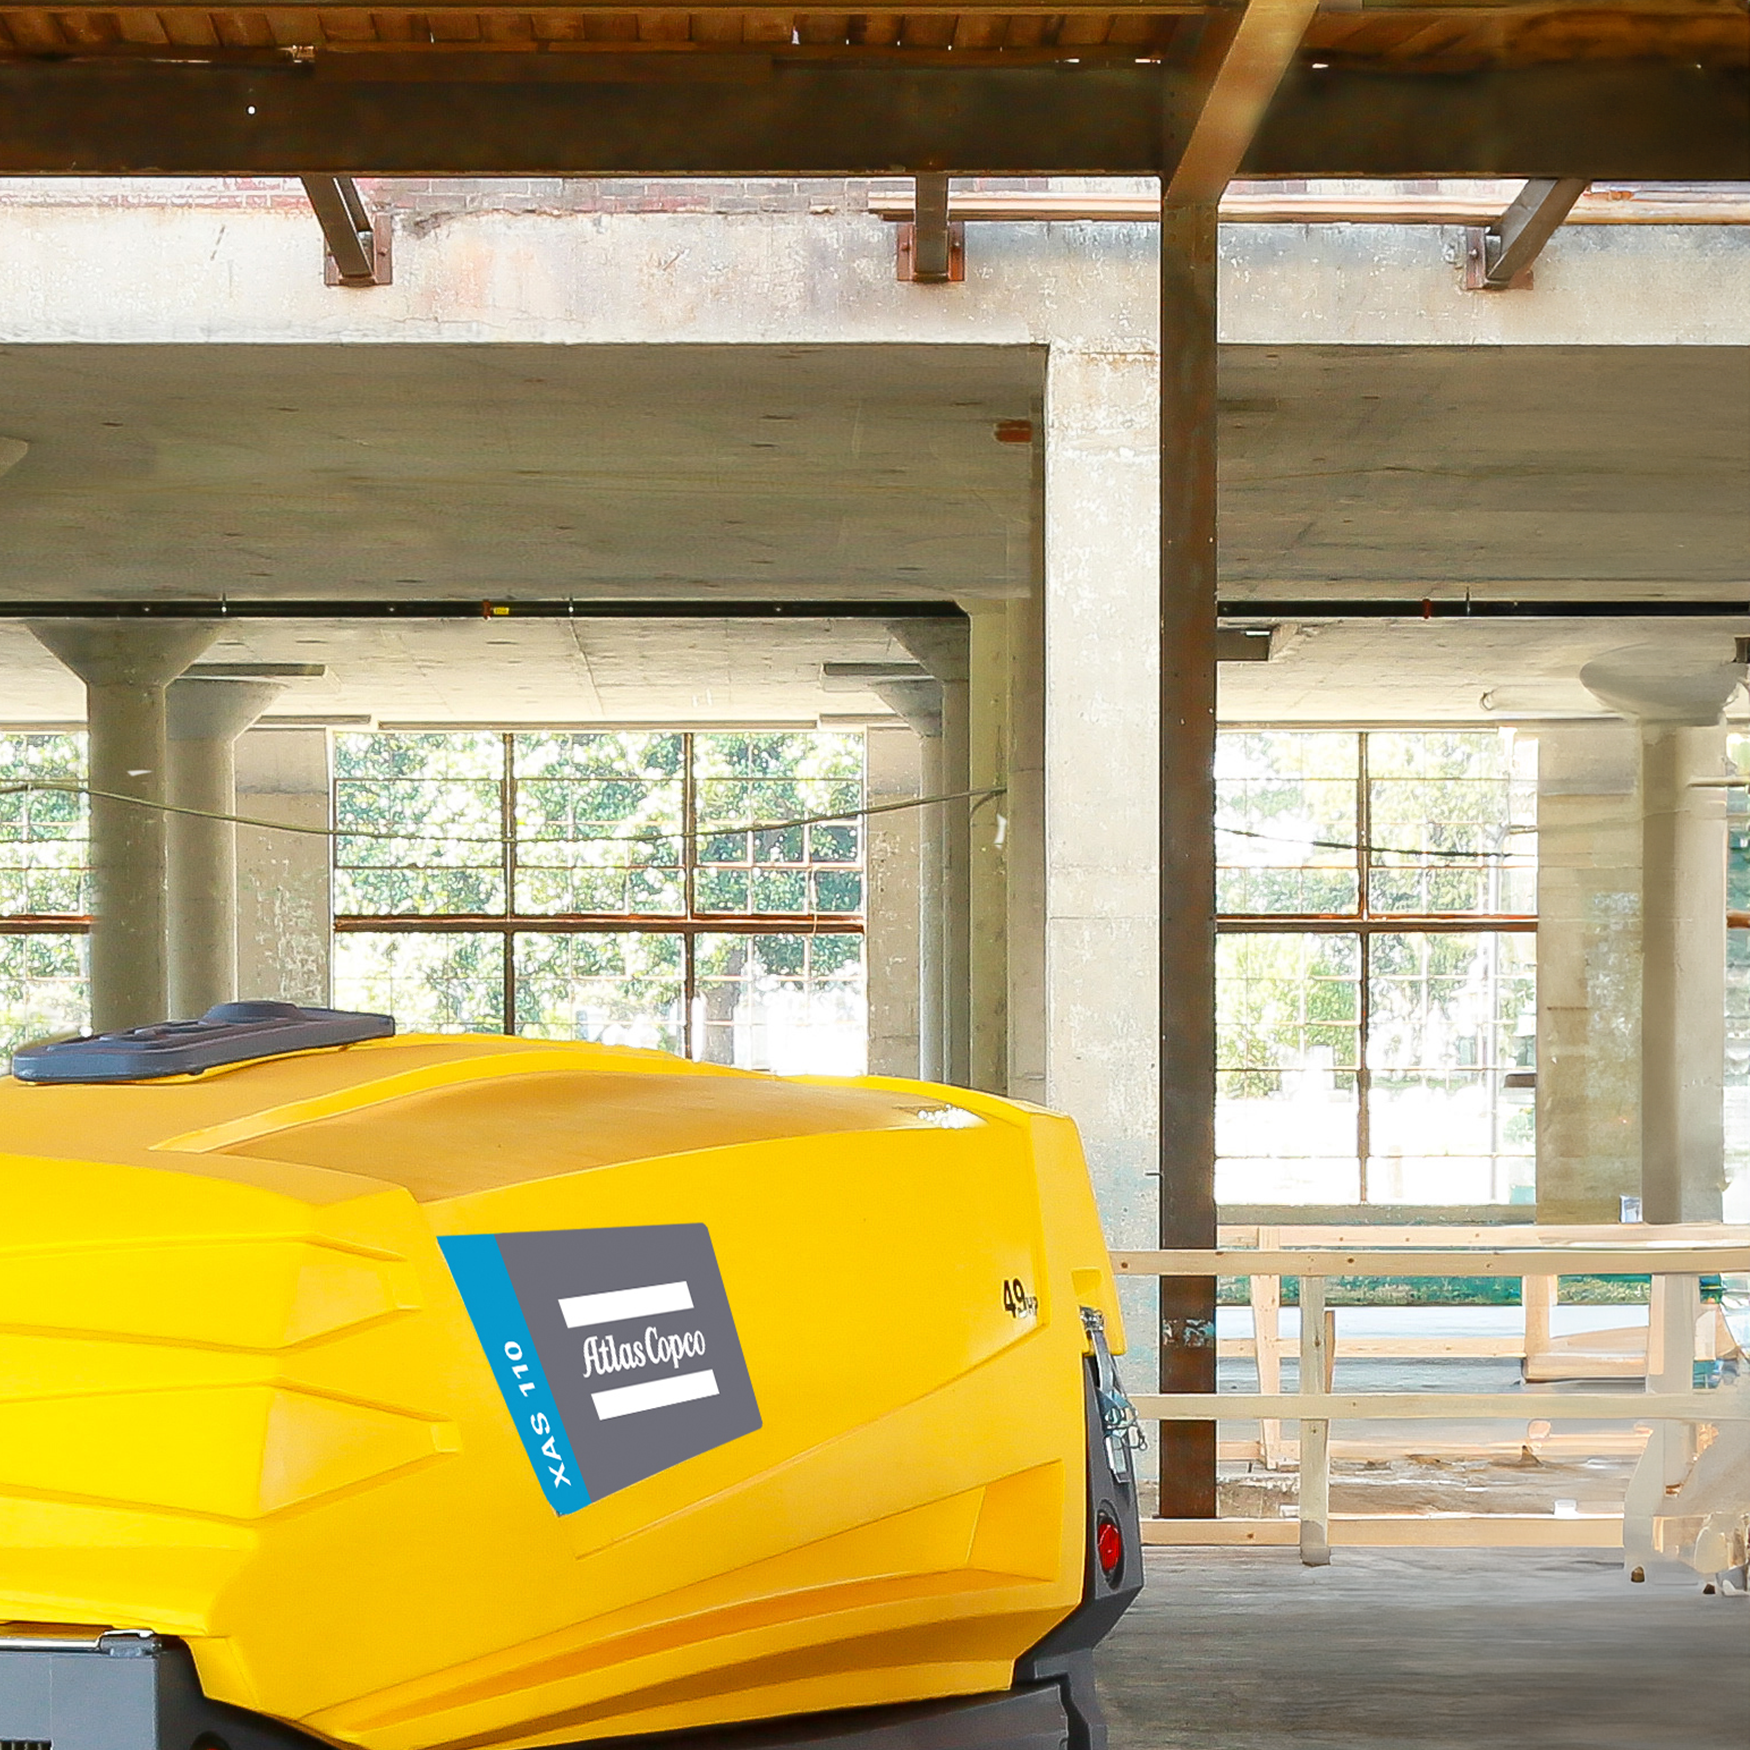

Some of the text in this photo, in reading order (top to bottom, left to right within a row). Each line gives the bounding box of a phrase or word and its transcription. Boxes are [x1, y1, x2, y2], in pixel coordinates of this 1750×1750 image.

[1003, 1278, 1027, 1319] 49
[582, 1326, 706, 1378] Atlas Copco
[503, 1340, 572, 1489] XAS 110
